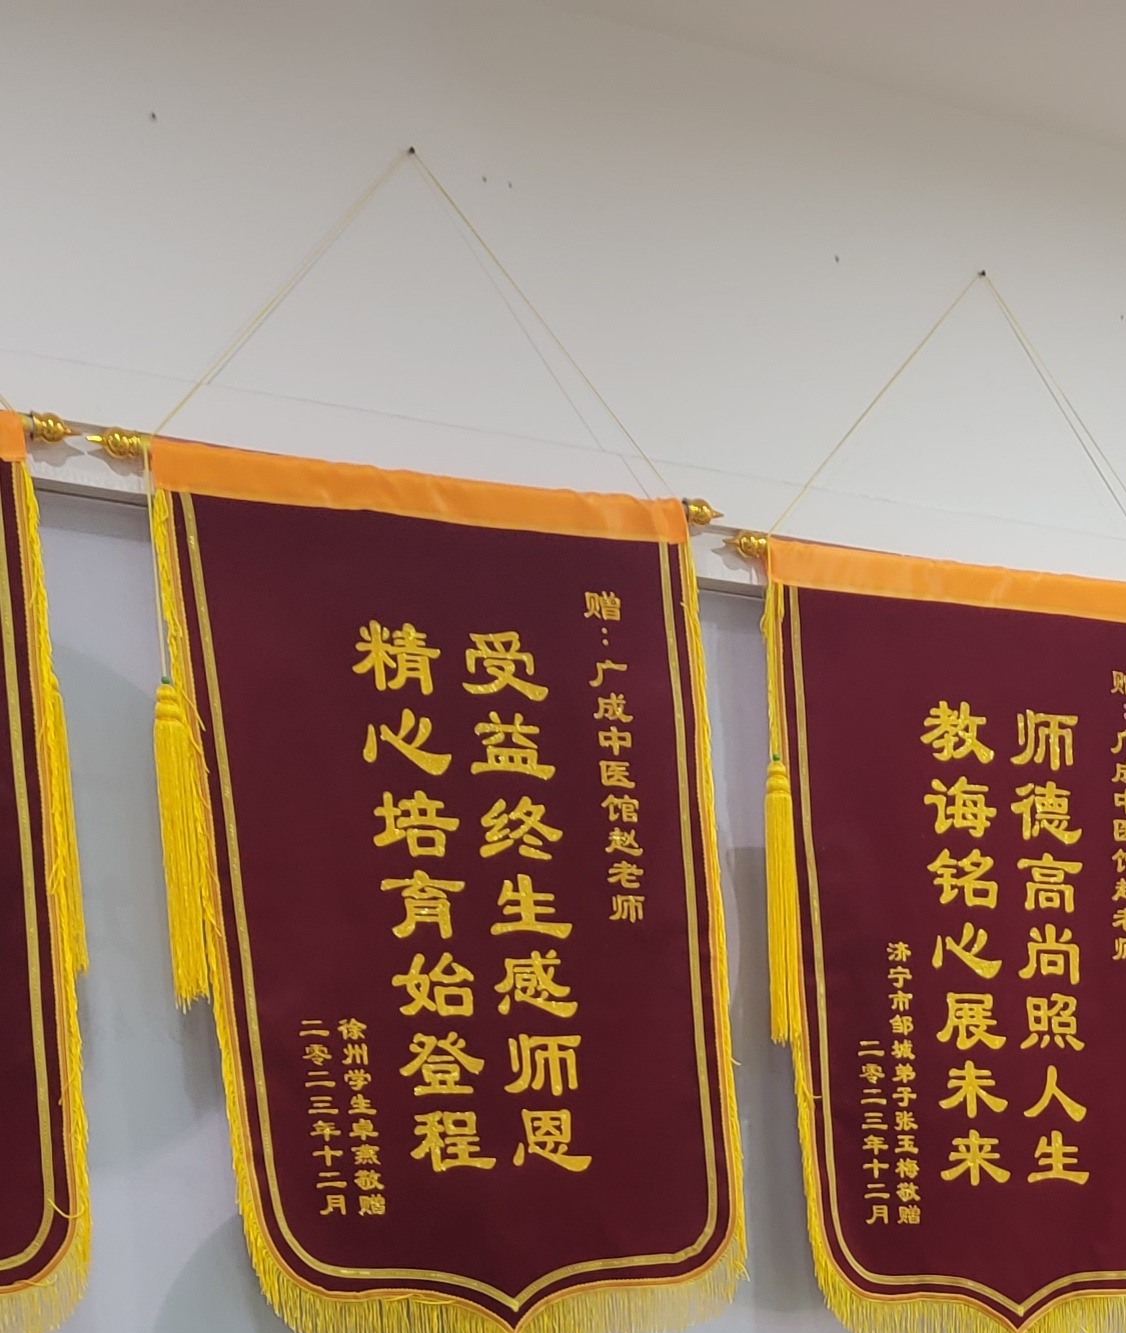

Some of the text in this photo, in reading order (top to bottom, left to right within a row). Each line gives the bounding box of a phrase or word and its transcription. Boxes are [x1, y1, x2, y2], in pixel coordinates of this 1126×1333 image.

[352, 619, 497, 1173] 精心培育始登程
[462, 631, 592, 1172] 受益终生感师恩
[886, 941, 921, 1224] 济宁市邹城弟子张玉梅敬赠
[919, 700, 1011, 1187] 教诲铭心展未来
[1009, 708, 1090, 1185] 师德高尚照人生
[299, 1020, 348, 1216] 二零二三年十二月
[337, 1017, 386, 1217] 徐州学生卓燕敬赠
[857, 1040, 891, 1225] 二零二三年十二月
